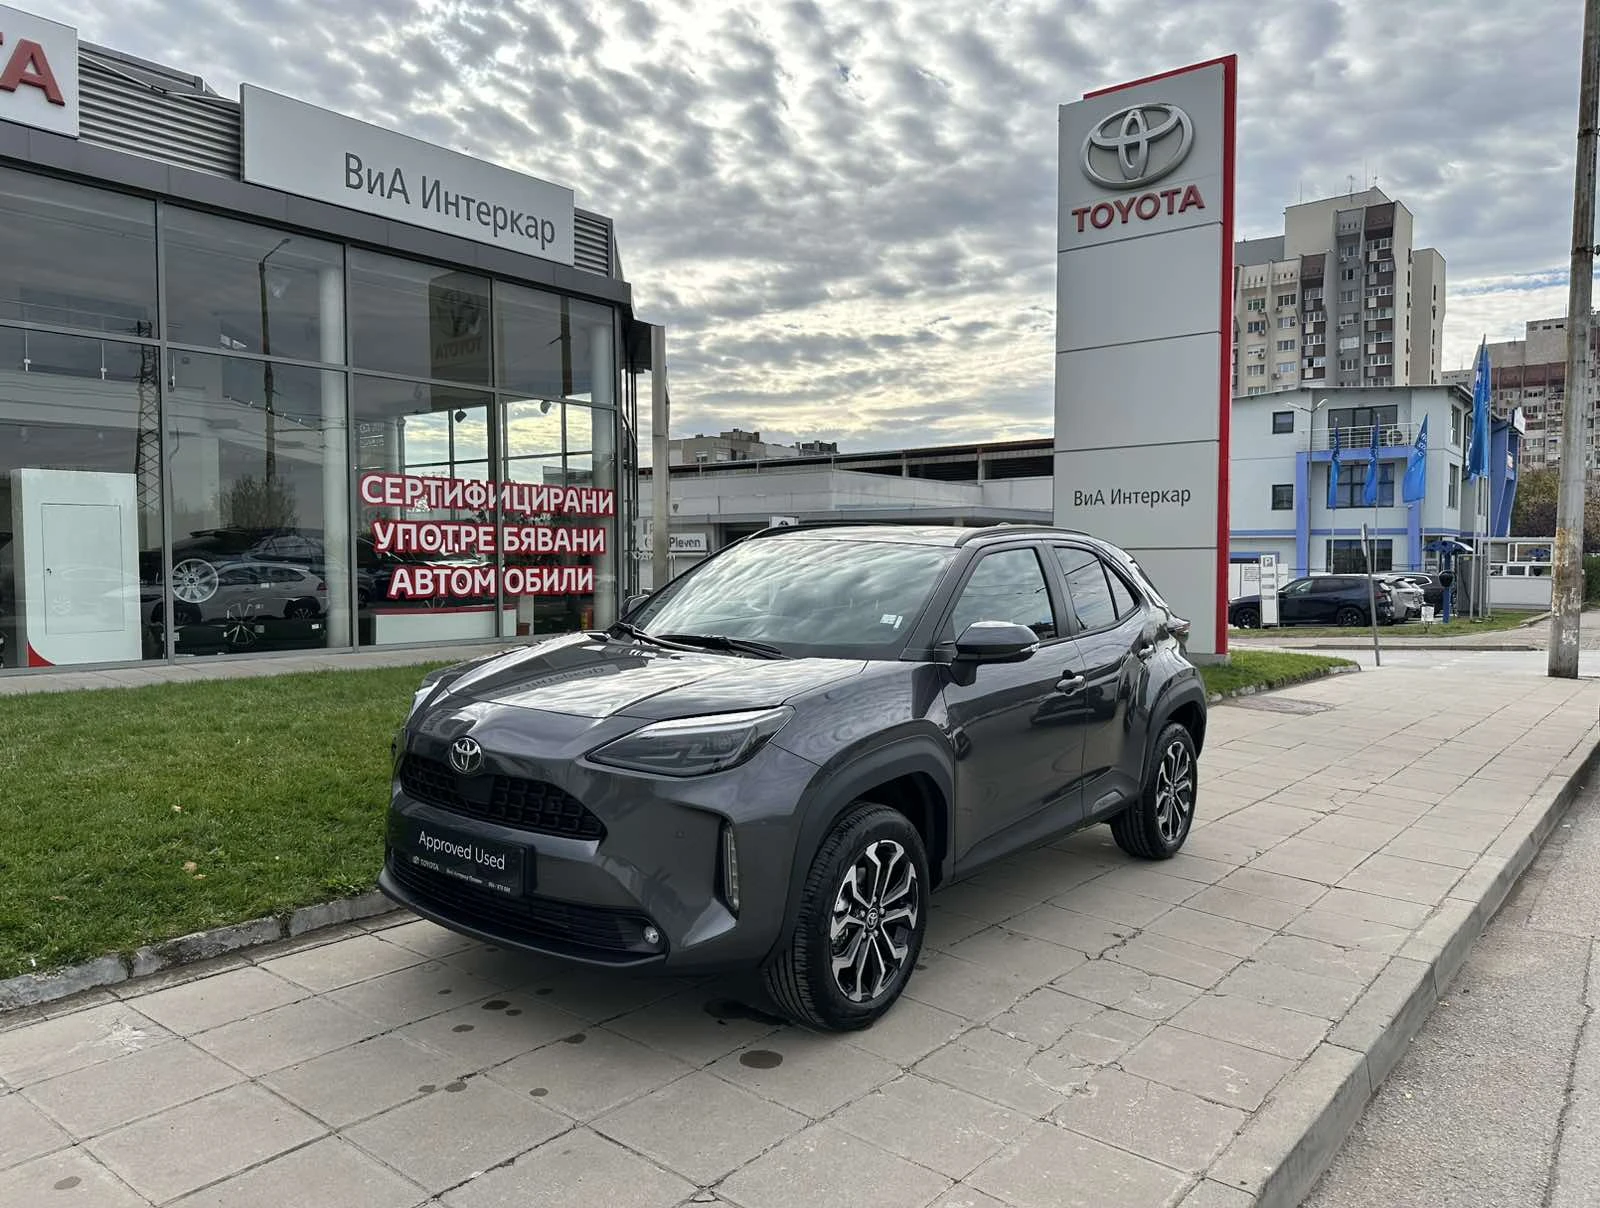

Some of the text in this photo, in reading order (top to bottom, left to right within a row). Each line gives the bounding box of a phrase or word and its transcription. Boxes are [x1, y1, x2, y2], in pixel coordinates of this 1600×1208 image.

[345, 152, 555, 250] ВиА Интеркар
[1072, 184, 1206, 232] TOYOTA
[361, 474, 614, 514] СЕРТИФИЦИРАНИ
[1074, 488, 1191, 508] ВиА Интеркар
[669, 537, 701, 548] Pleven
[418, 831, 505, 870] Approved Used
